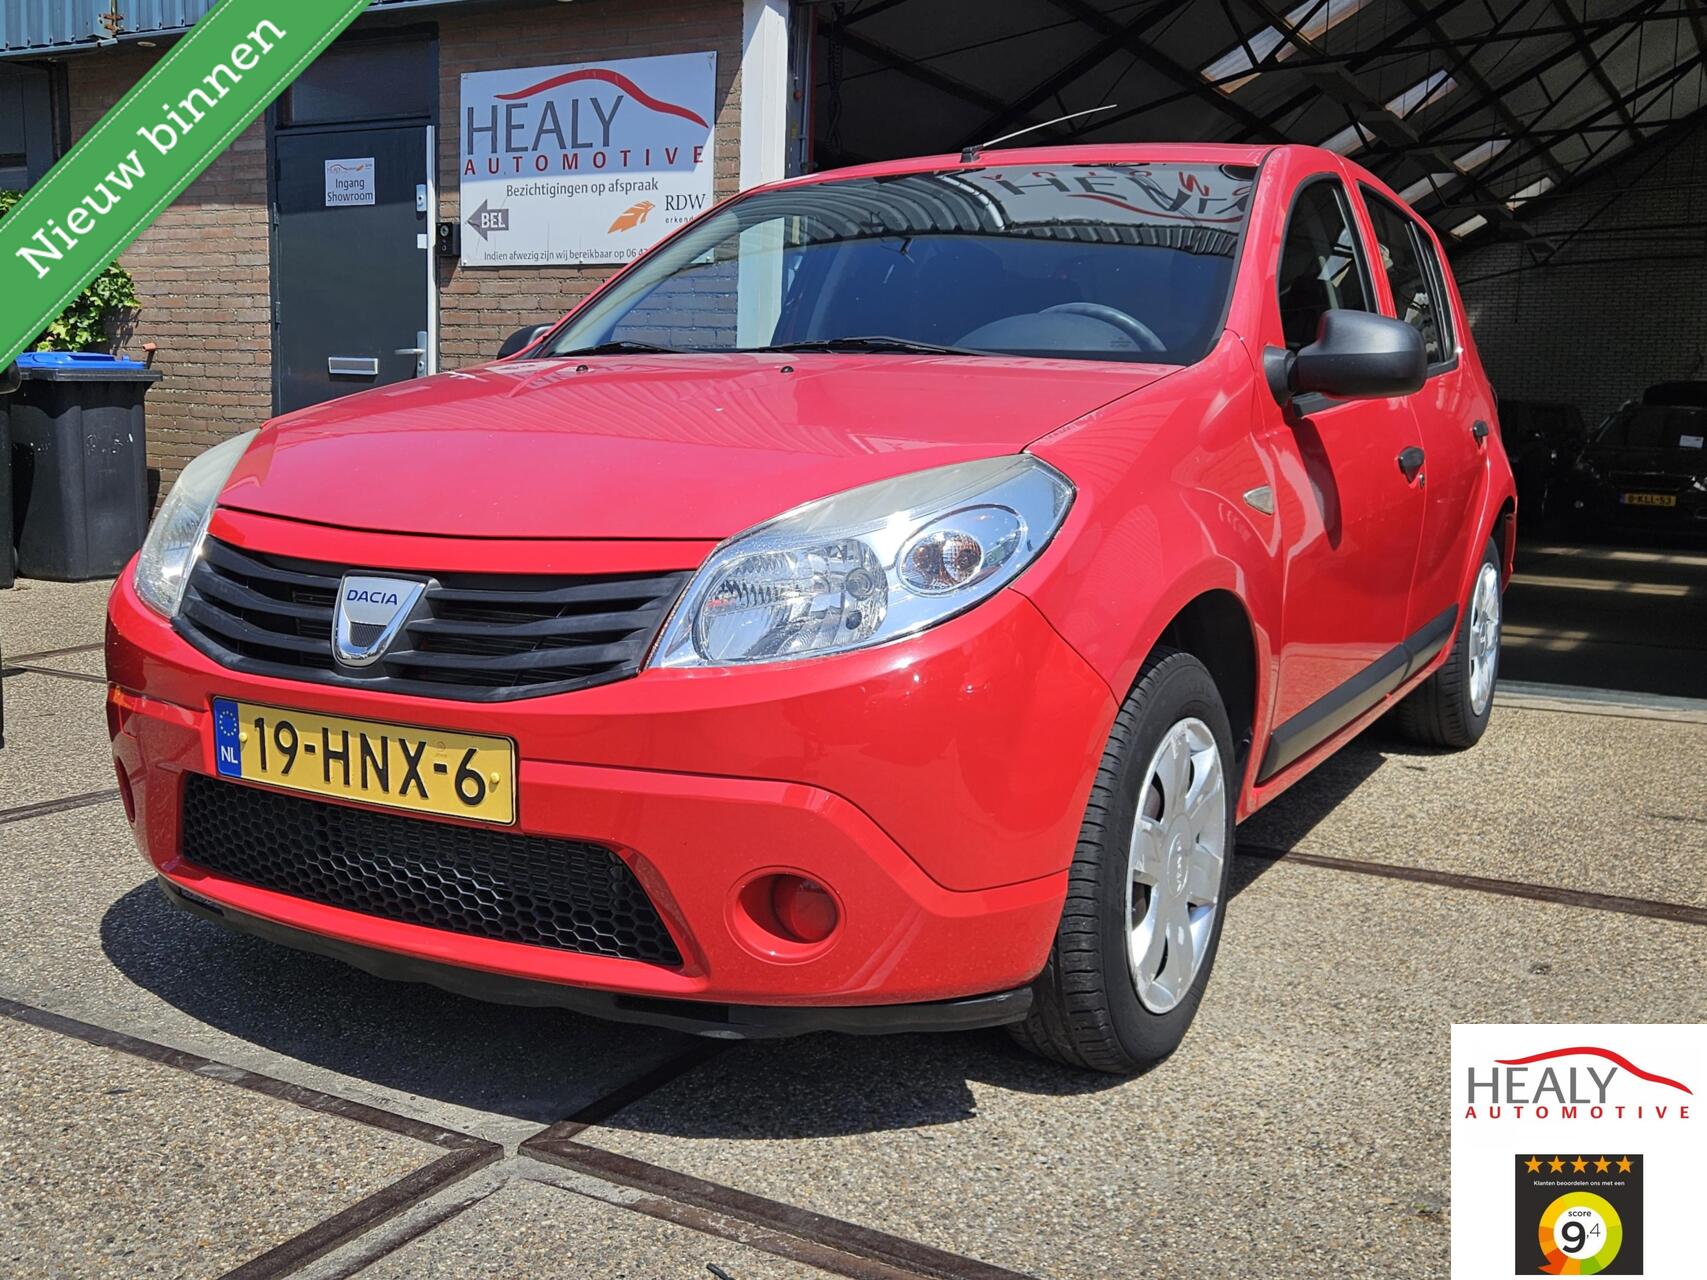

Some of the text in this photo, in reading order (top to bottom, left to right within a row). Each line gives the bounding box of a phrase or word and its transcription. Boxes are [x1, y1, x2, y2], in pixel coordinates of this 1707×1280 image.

[467, 95, 624, 156] HEALY
[464, 145, 704, 176] AUTOMOTIVE
[335, 178, 365, 190] Ingang
[506, 177, 659, 199] Bezichtigingen op afspraak
[327, 191, 374, 202] Showroom
[665, 193, 706, 211] RDW
[481, 212, 506, 228] BEL
[484, 251, 508, 261] Indien
[509, 250, 539, 262] afwezig
[540, 250, 555, 262] zijn
[556, 250, 568, 262] wij
[569, 248, 612, 259] bereikbaar
[614, 249, 625, 259] op
[626, 248, 637, 258] 06
[346, 589, 398, 605] DACIA
[220, 745, 238, 765] NL
[254, 717, 486, 806] 19-HNX-6
